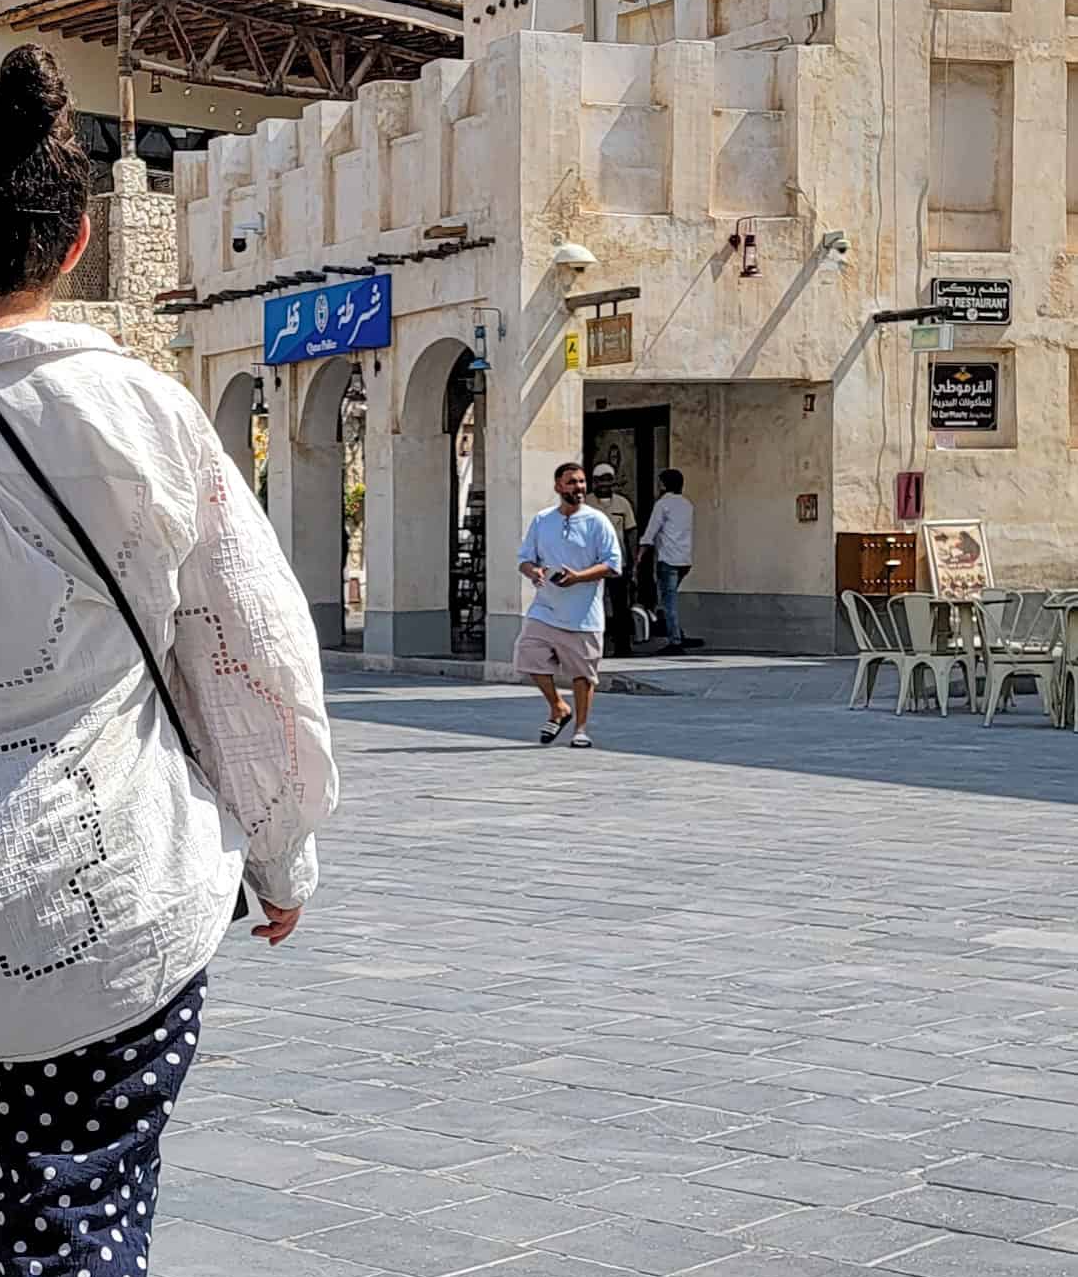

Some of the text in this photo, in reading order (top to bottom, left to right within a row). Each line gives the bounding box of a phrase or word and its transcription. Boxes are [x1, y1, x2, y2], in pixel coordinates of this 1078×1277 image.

[978, 283, 1008, 297] مطعم
[955, 297, 1007, 309] RESTAURANT
[267, 283, 382, 359] شرطة قطر
[932, 379, 993, 396] القرموطي
